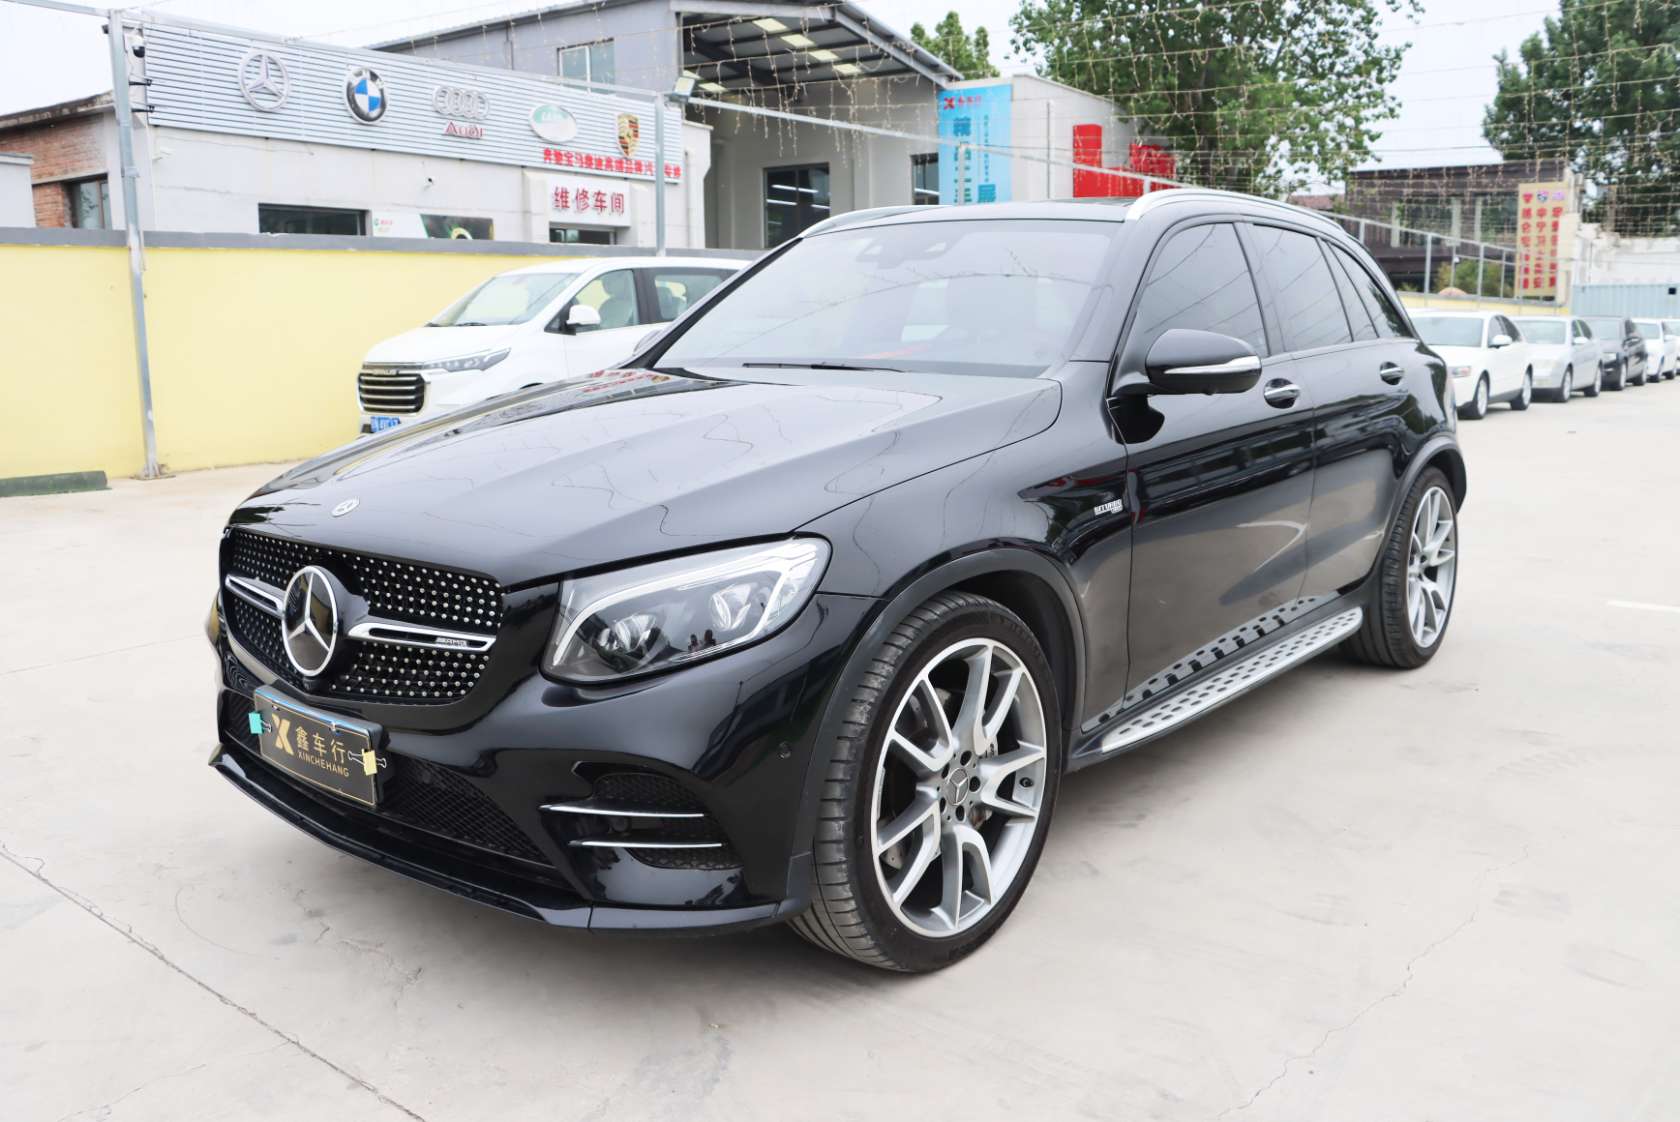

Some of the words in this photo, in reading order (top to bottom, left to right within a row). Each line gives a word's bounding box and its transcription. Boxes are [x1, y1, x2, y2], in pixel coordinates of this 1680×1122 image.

[445, 121, 483, 138] Audi
[553, 187, 625, 216] 维修车间
[296, 726, 345, 764] 鑫车行
[298, 751, 349, 777] XINCHEHANG
